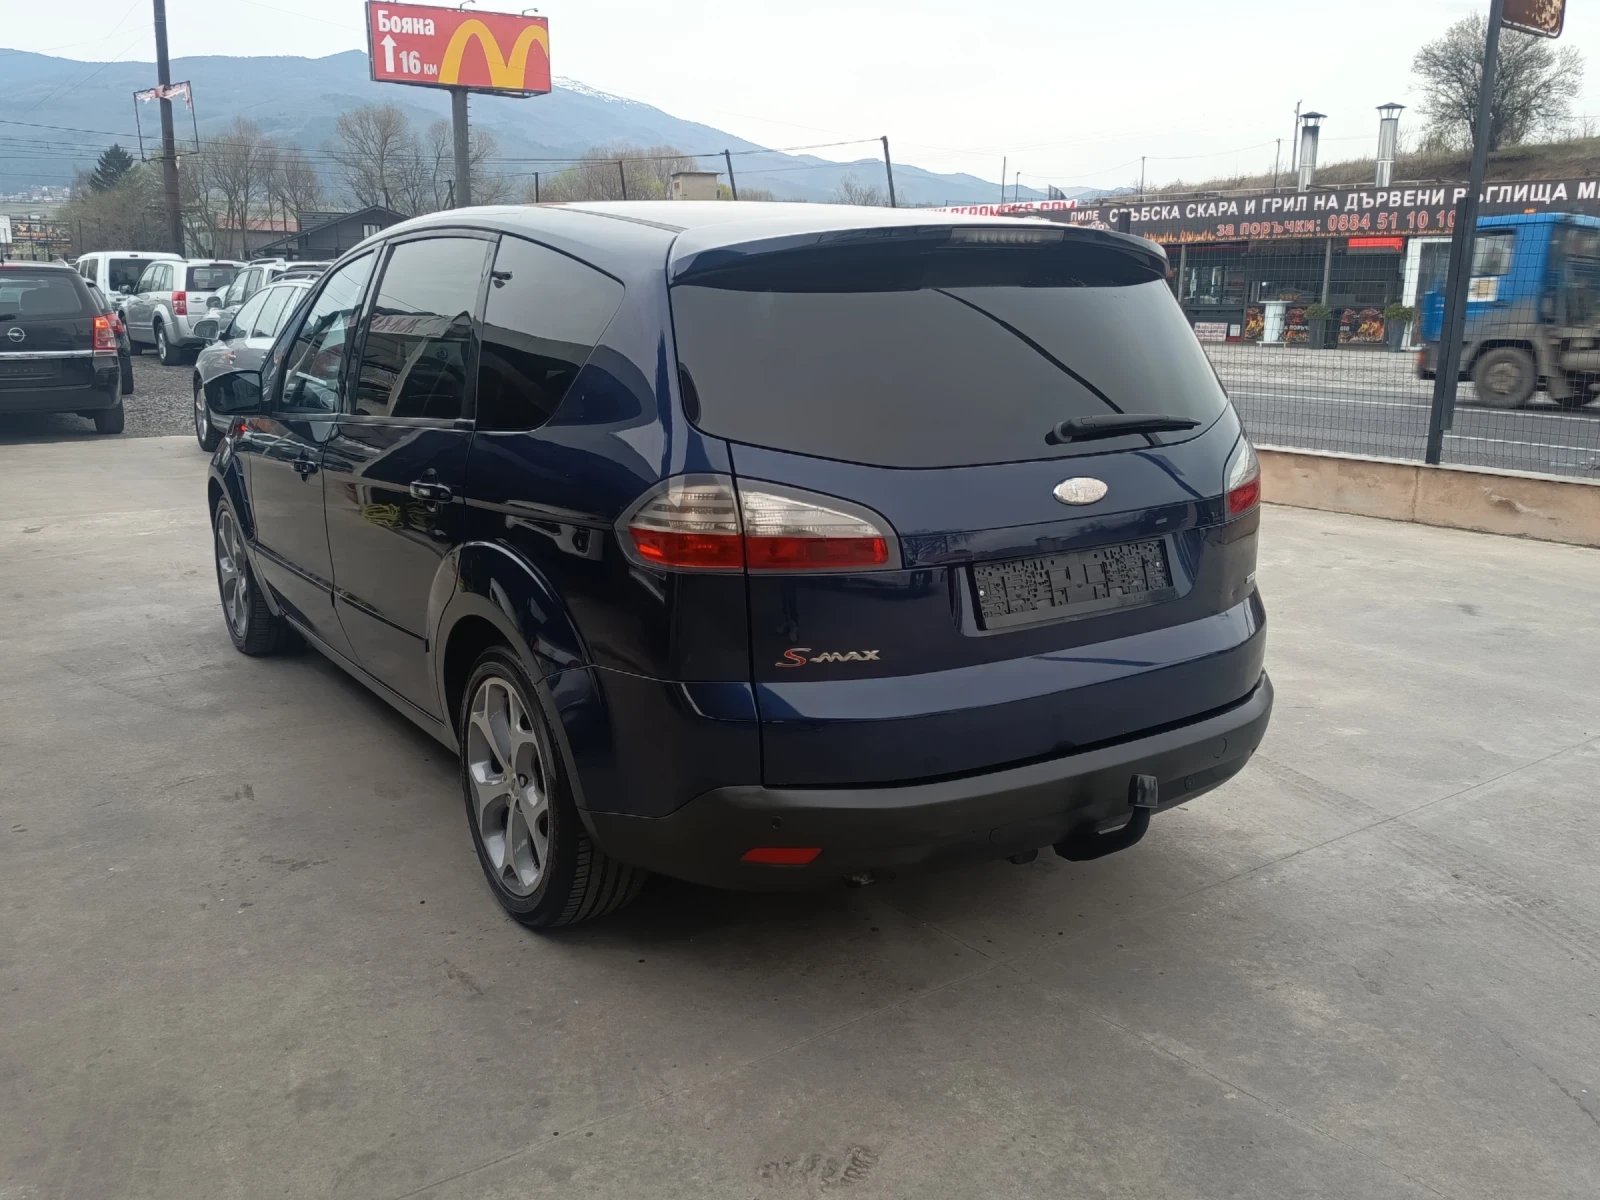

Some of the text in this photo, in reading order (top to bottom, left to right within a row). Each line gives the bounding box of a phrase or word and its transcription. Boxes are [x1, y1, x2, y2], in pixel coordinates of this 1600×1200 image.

[377, 9, 435, 36] Бояна
[399, 50, 421, 74] 16
[1070, 210, 1100, 222] ПИЛЕ
[1186, 200, 1239, 219] СКАРА
[1244, 199, 1256, 215] И
[1261, 196, 1307, 214] ГРИЛ
[1313, 194, 1339, 211] НА
[1344, 188, 1445, 212] ДЪРВЕНИ
[1216, 223, 1235, 237] за
[1240, 219, 1321, 237] поръчки:
[1328, 213, 1370, 232] 0884
[1377, 212, 1398, 230] 51
[1407, 210, 1429, 229] 10
